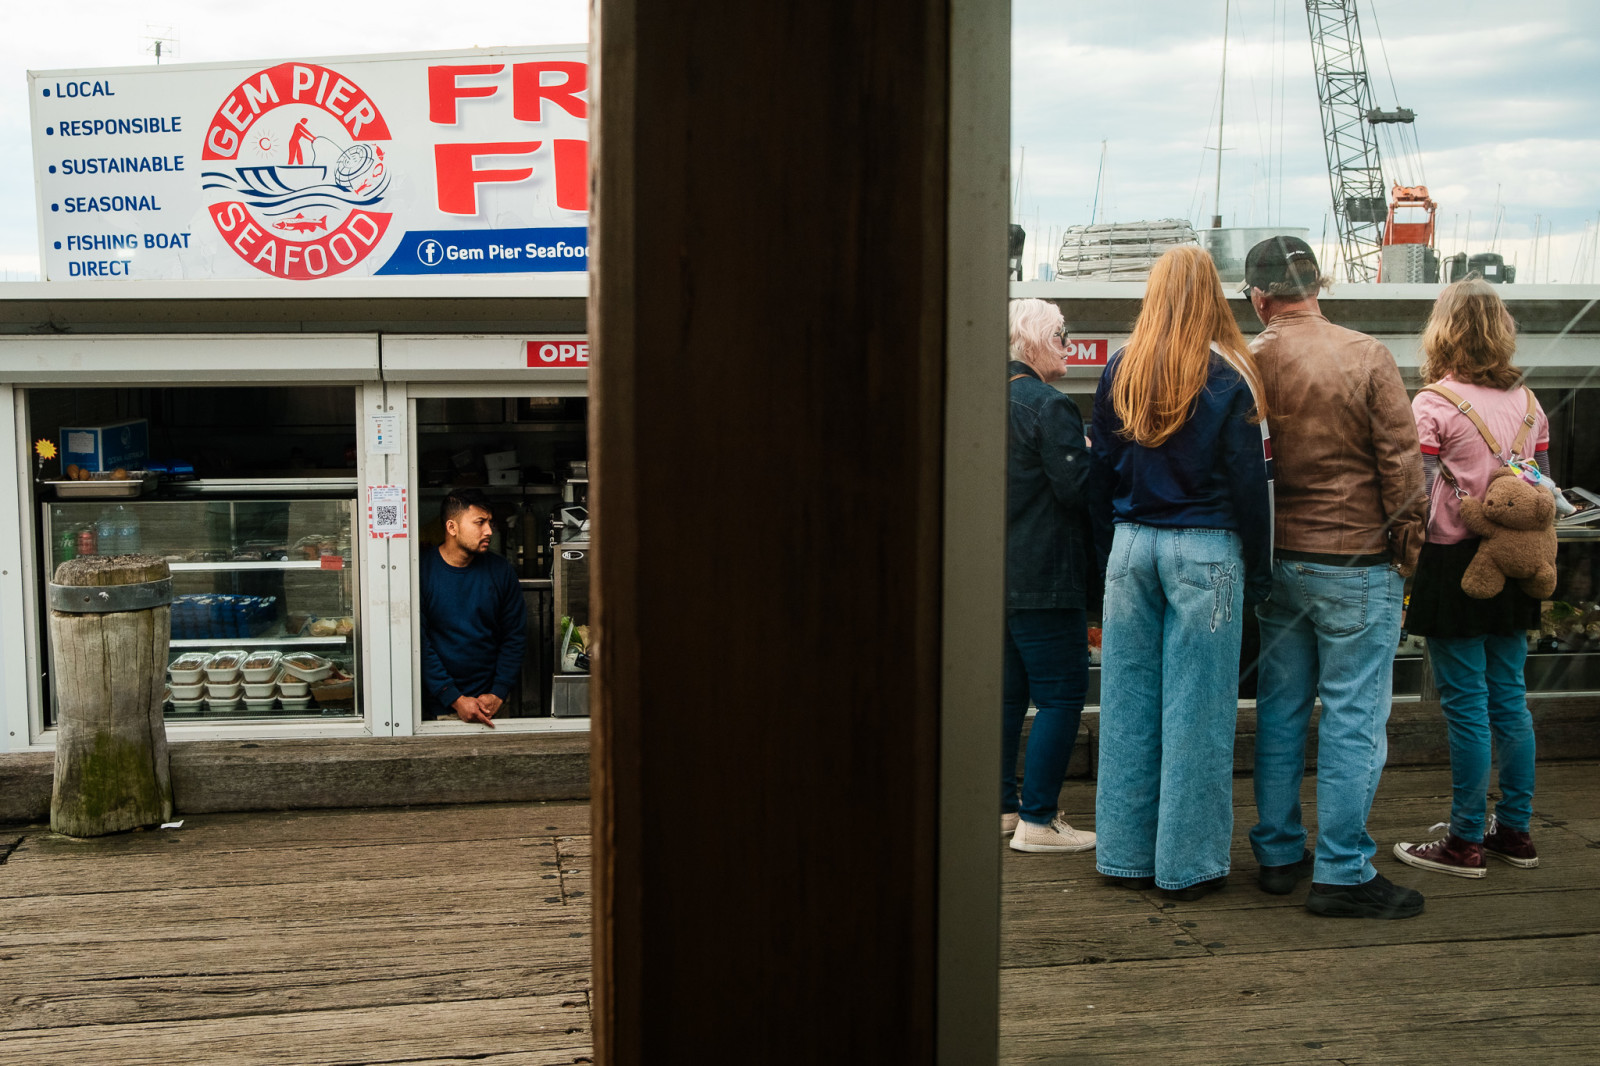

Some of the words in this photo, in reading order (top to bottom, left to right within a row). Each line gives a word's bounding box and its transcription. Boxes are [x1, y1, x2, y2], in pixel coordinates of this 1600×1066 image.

[56, 80, 115, 98] LOCAL
[427, 60, 588, 125] FR
[208, 73, 280, 158] GEM
[292, 65, 376, 138] PIER
[59, 116, 182, 136] RESPONSIBLE
[61, 155, 185, 175] SUSTAINABLE
[64, 195, 162, 213] SEASONAL
[67, 233, 138, 251] FISHING
[144, 232, 191, 249] BOAT
[216, 202, 379, 276] SEAFOOD
[446, 245, 484, 261] Gem
[488, 244, 522, 260] Pier
[68, 260, 131, 277] DIRECT
[539, 344, 589, 363] OPE
